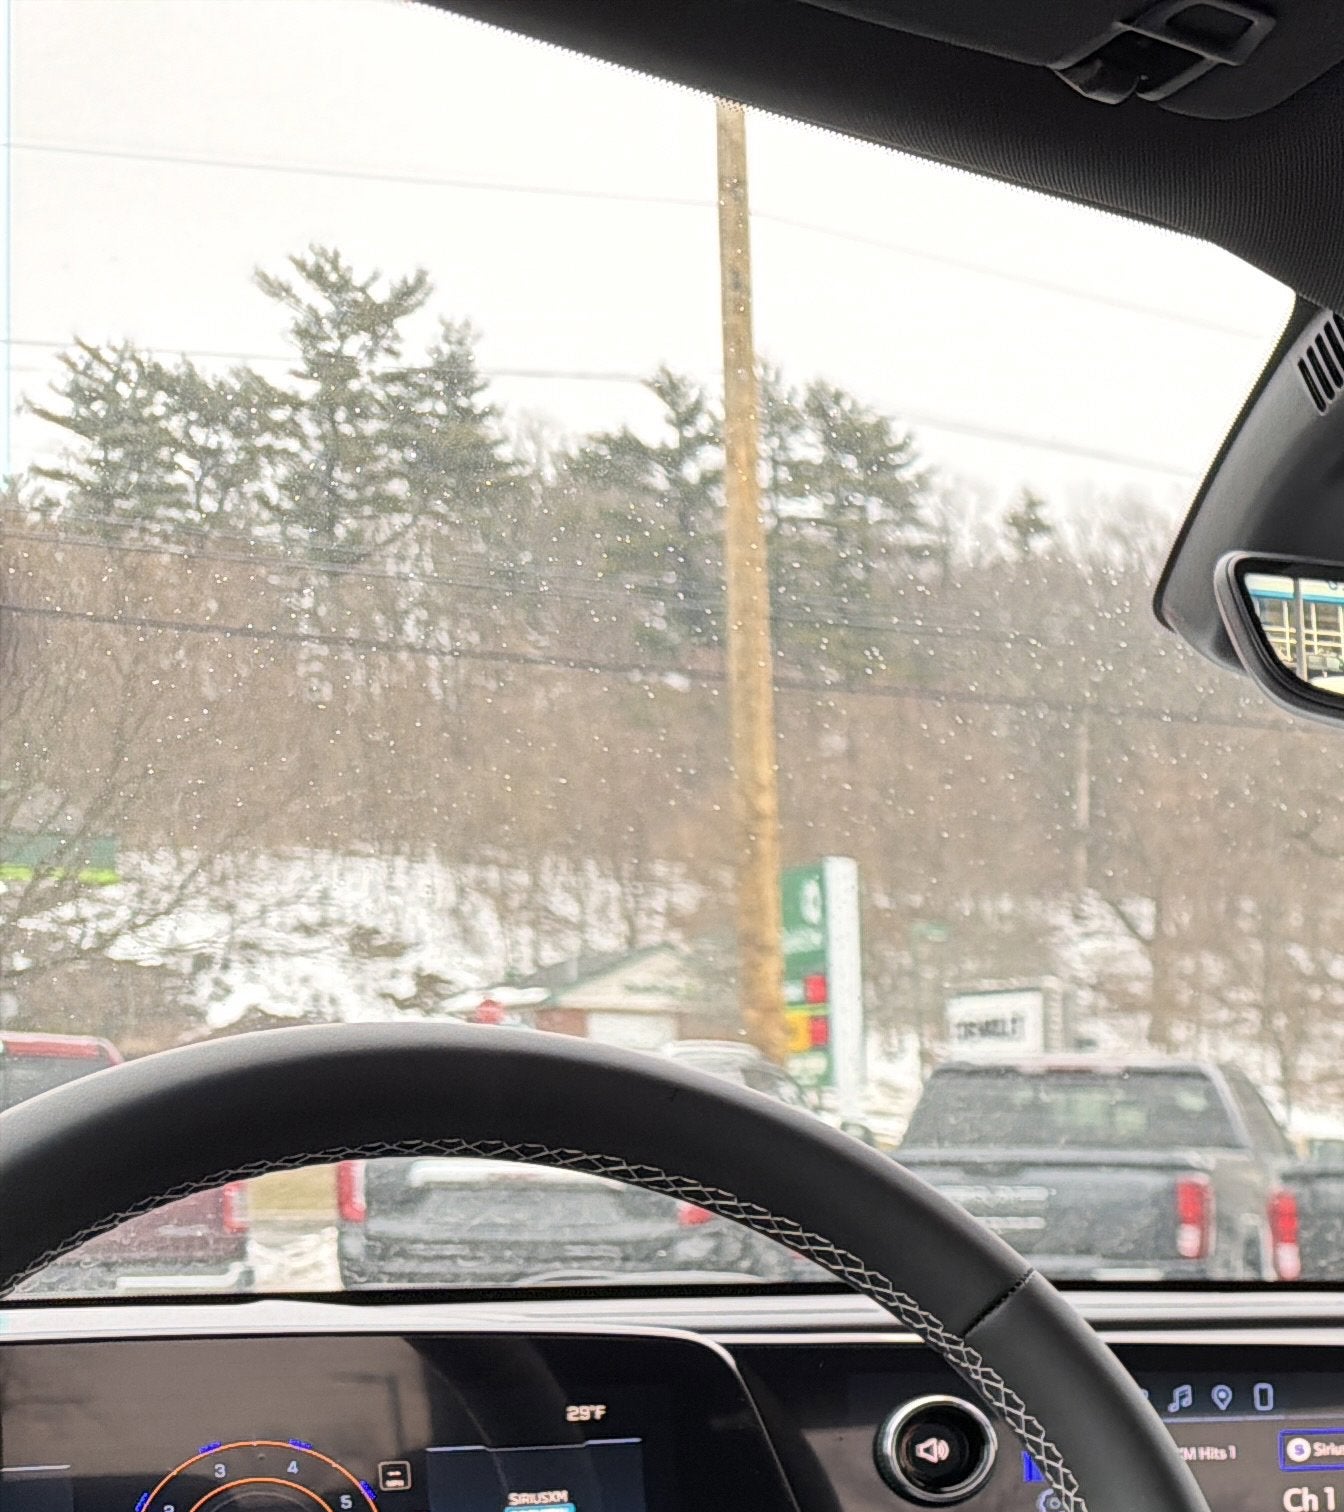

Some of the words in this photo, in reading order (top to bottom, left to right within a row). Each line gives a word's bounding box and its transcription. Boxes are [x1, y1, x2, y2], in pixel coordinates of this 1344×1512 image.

[214, 1463, 226, 1478] 3
[287, 1460, 299, 1475] 4
[340, 1494, 353, 1510] 5
[508, 1490, 569, 1506] SIRIUSXM
[1325, 1486, 1336, 1510] 1
